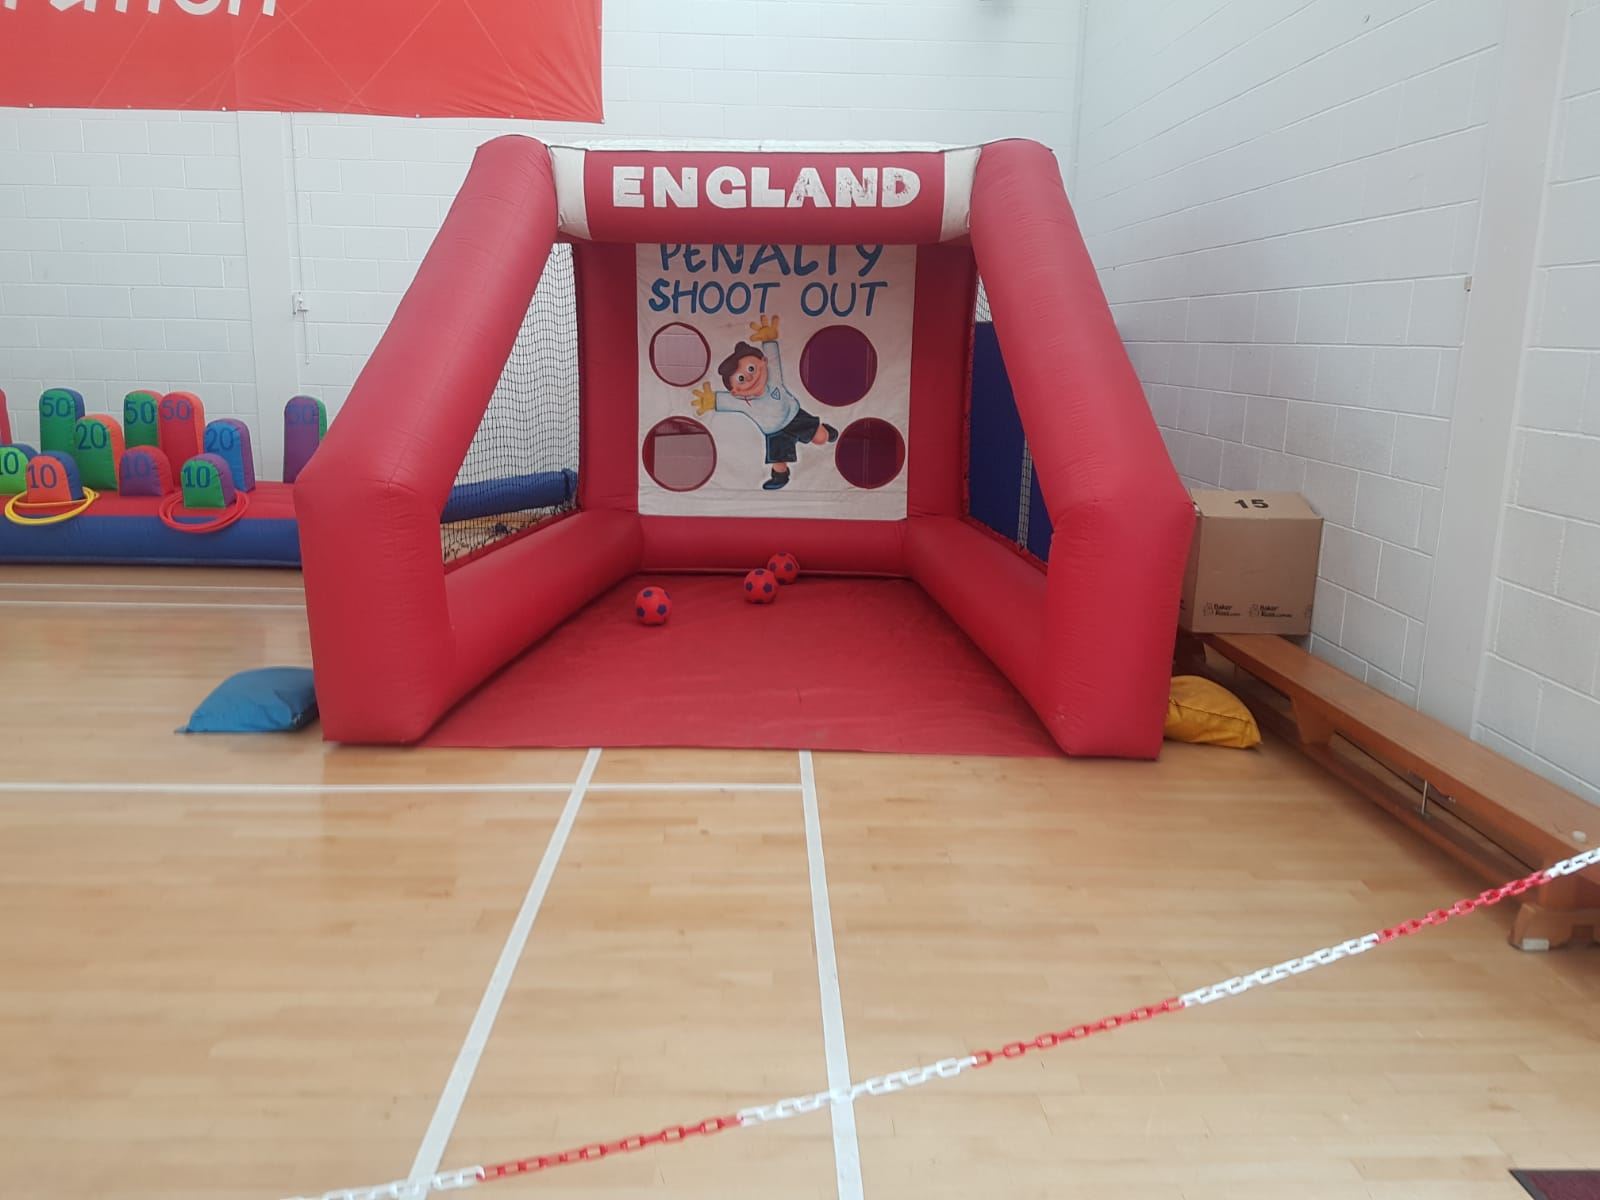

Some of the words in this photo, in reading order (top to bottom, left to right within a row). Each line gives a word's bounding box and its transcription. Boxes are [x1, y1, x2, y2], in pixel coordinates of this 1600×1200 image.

[613, 166, 920, 208] ENGLAND
[648, 278, 780, 313] SHOOT
[800, 281, 888, 317] OUT
[41, 397, 72, 418] 50
[125, 400, 155, 424] 50
[162, 399, 191, 421] 50
[76, 422, 107, 450] 20
[206, 428, 234, 452] 20
[0, 451, 19, 475] 0
[124, 457, 149, 478] 10
[28, 463, 57, 489] 10
[184, 466, 210, 488] 10
[1235, 499, 1269, 509] 15
